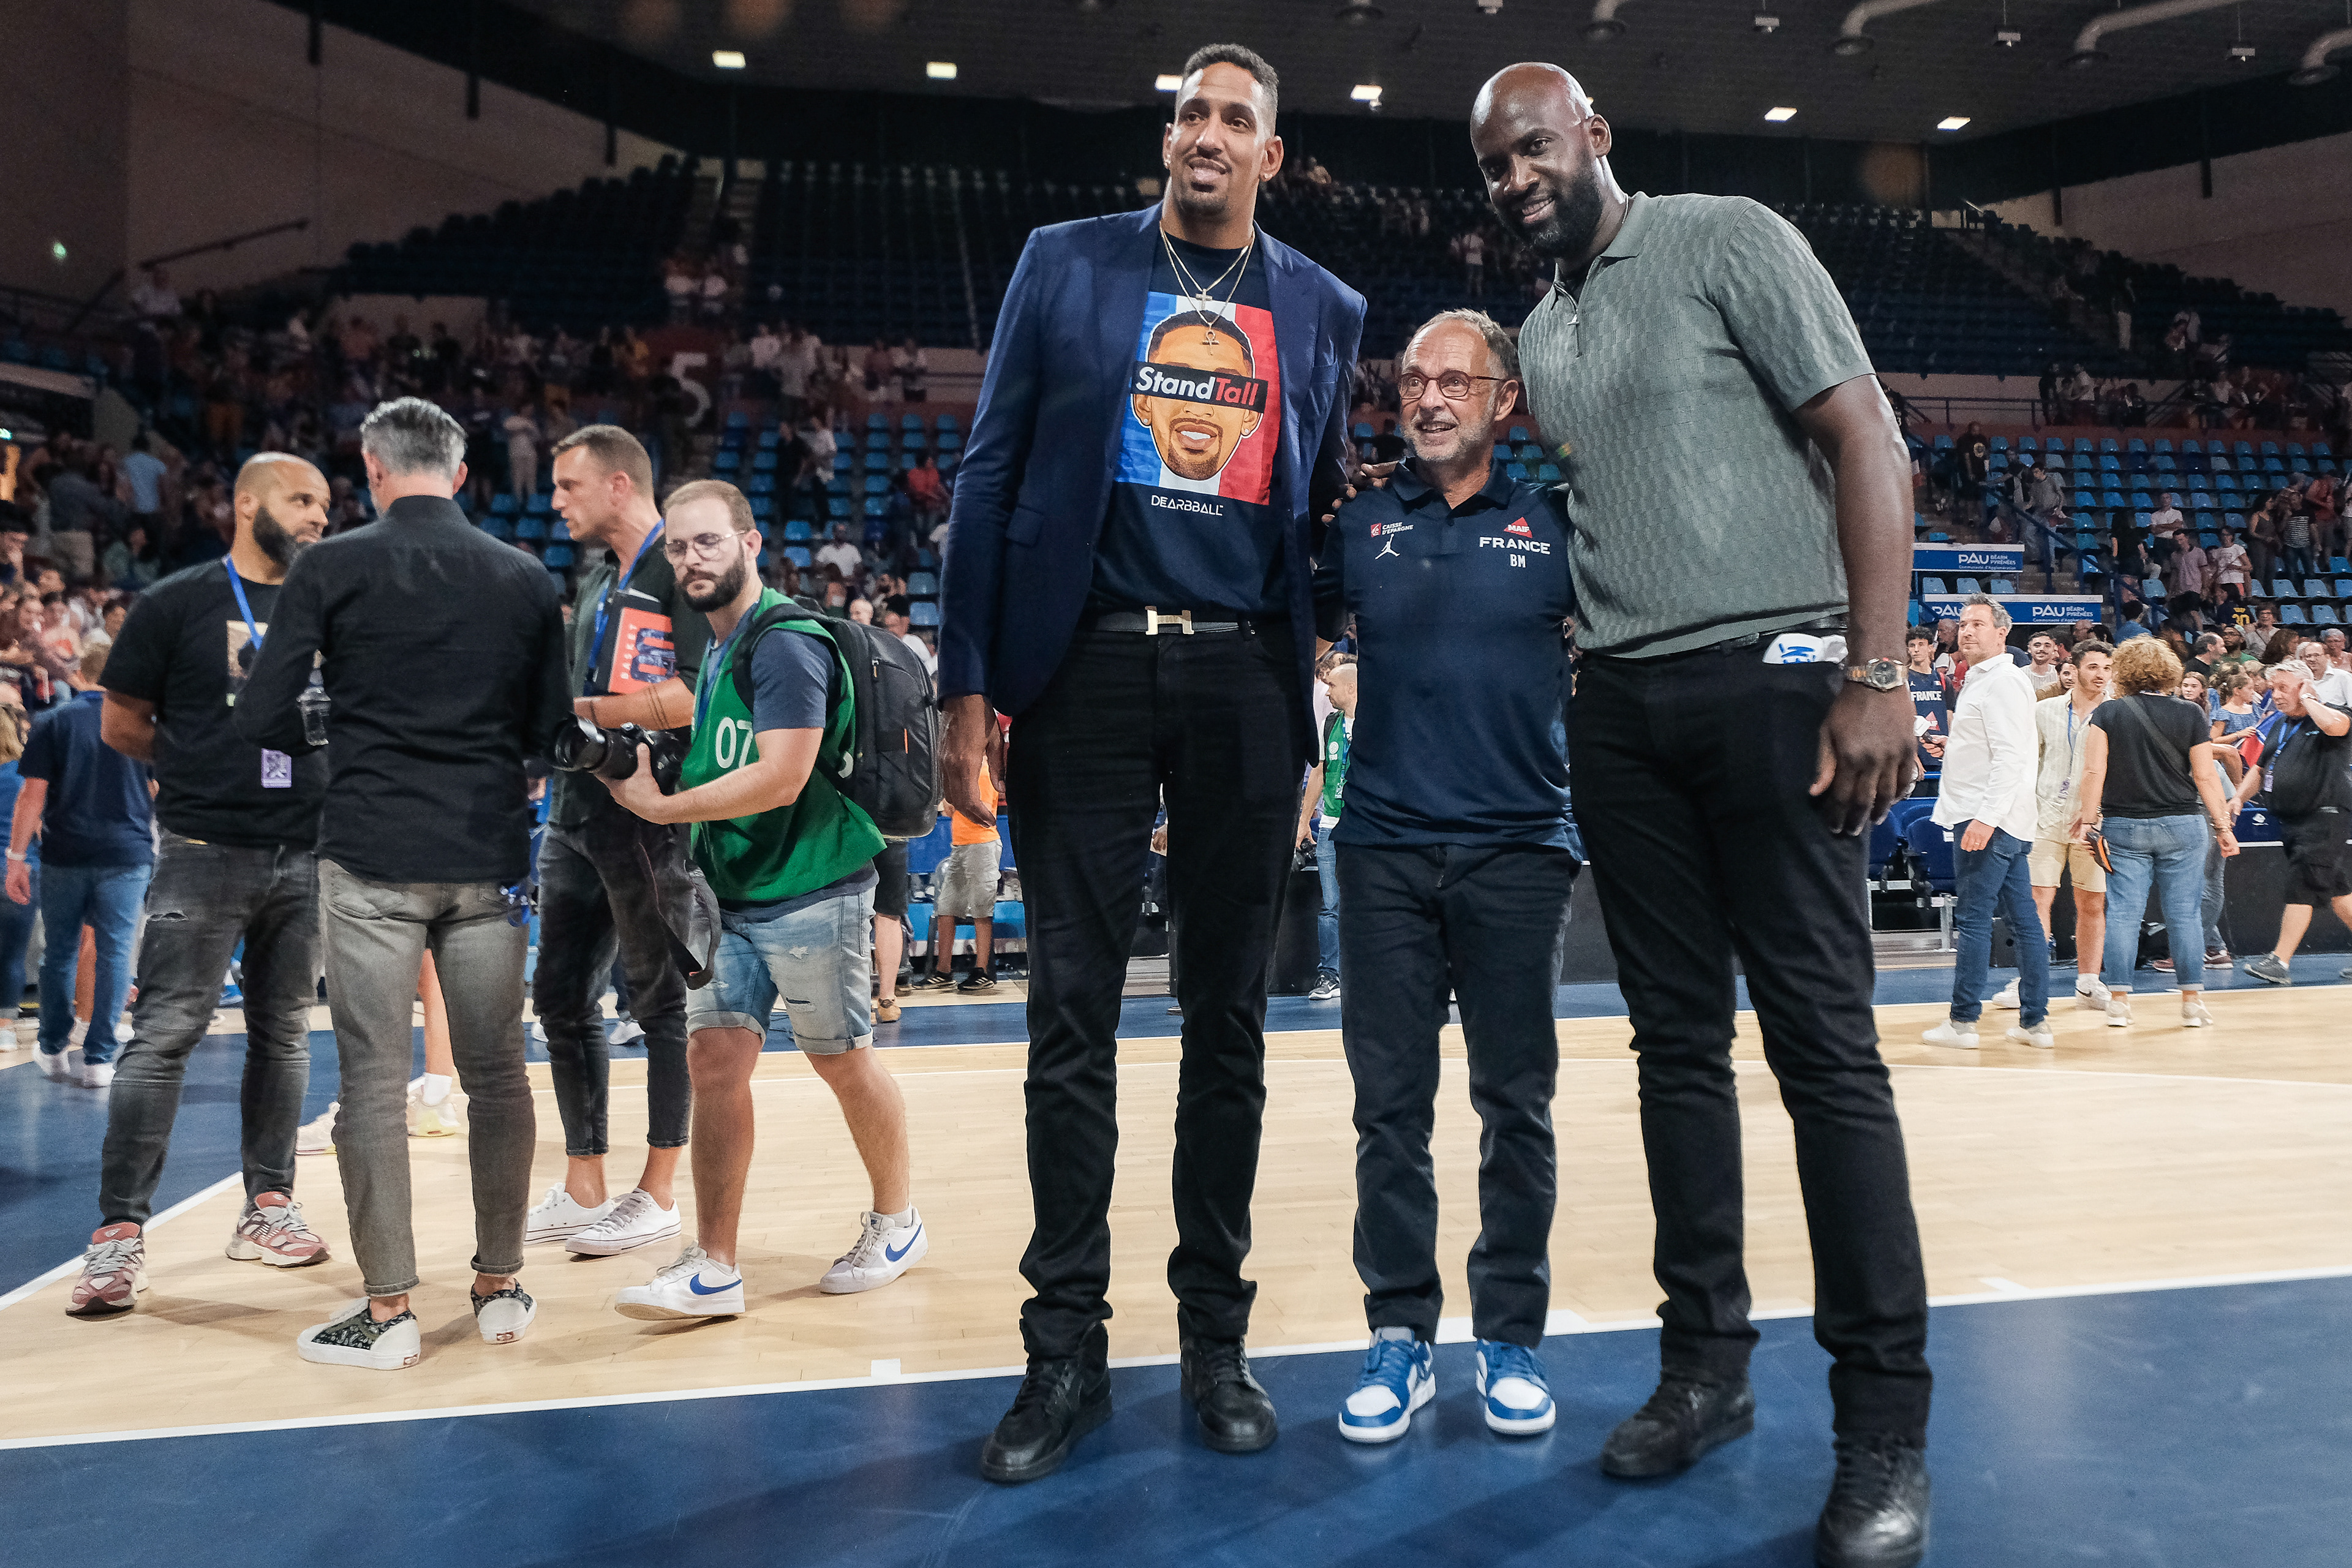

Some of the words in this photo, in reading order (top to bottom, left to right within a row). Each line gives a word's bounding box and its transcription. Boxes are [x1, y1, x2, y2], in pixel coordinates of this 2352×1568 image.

[1151, 495, 1224, 516] DEARBBALL
[1507, 524, 1530, 533] MAIF
[1479, 537, 1550, 555] FRANCE
[1510, 554, 1526, 568] BM
[1958, 552, 1989, 565] PAU
[2032, 605, 2065, 617] PAU
[1910, 690, 1942, 701] FRANCE
[715, 717, 753, 769] 07
